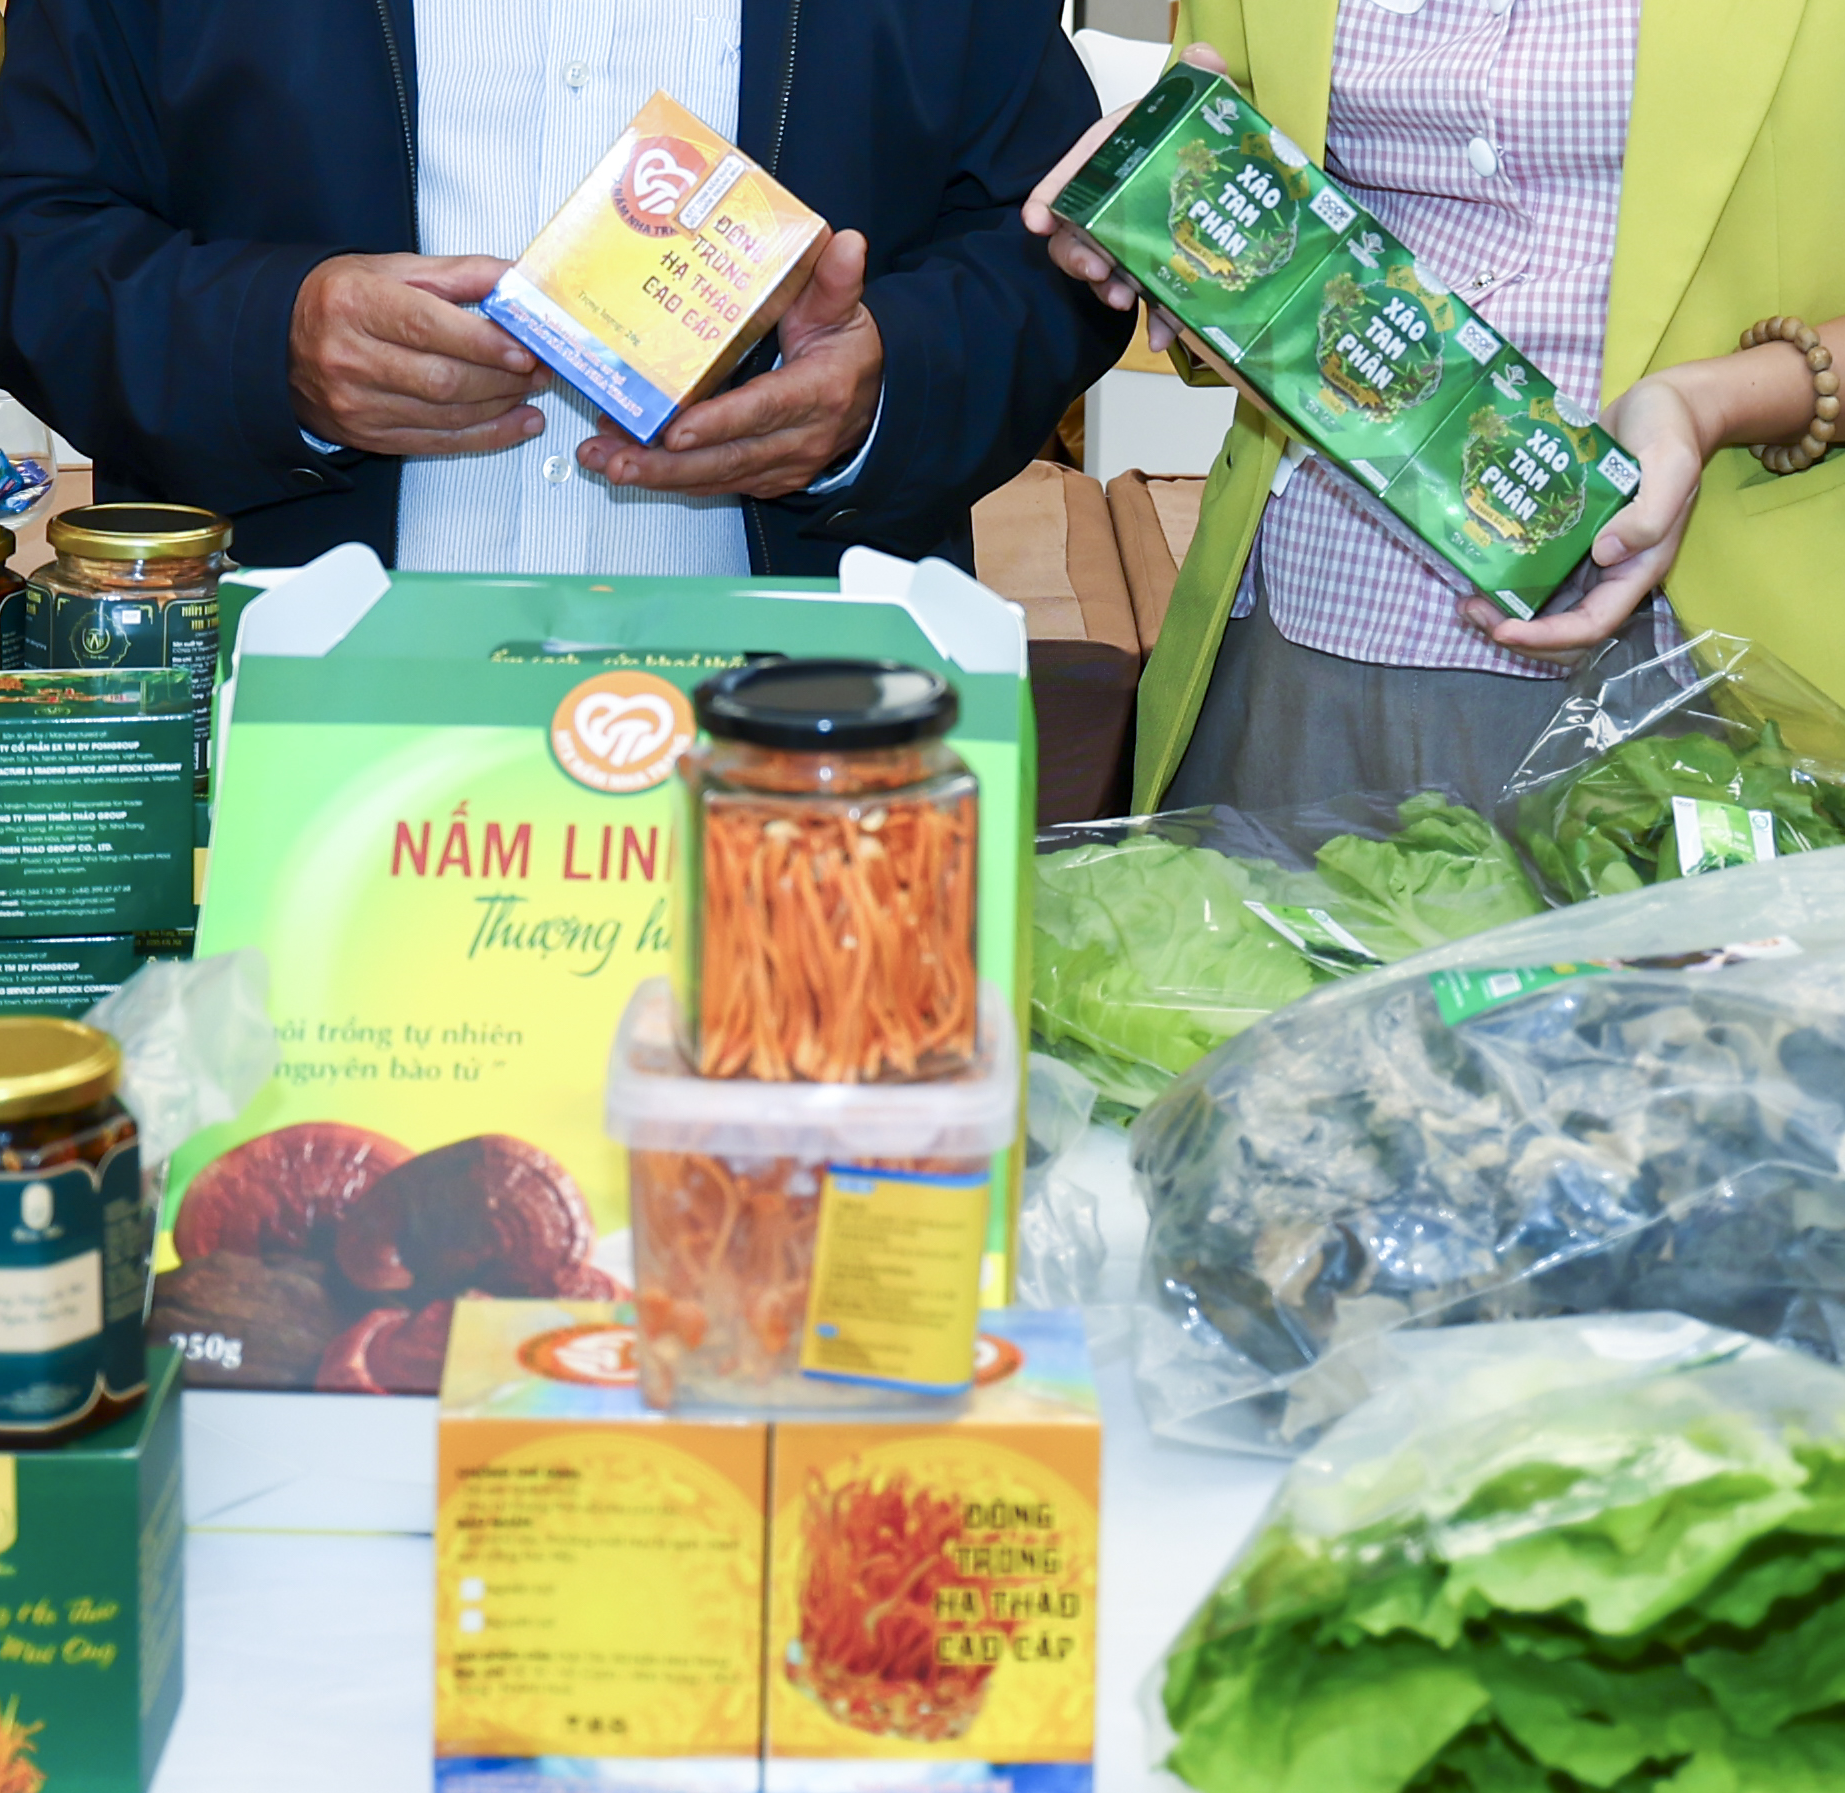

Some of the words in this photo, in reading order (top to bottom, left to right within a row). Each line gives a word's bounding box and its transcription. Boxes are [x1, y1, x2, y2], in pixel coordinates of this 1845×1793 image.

[1217, 181, 1261, 228] TAM
[1236, 164, 1282, 209] XÁO
[1321, 194, 1350, 220] OCOP
[627, 213, 652, 235] NHA
[713, 215, 768, 264] ĐÔNG
[1187, 199, 1248, 258] PHÂN
[691, 235, 751, 291] TRÙNG
[642, 276, 683, 313] CAO
[681, 308, 722, 342] CẤP
[660, 250, 690, 282] HẠ
[690, 273, 742, 324] THẢO
[1365, 315, 1408, 361] TAM
[1382, 296, 1427, 342] XÁO
[1467, 325, 1494, 350] OCOP
[1336, 333, 1395, 390] PHÂN
[1509, 447, 1551, 492] TAM
[1526, 428, 1570, 472] XÁO
[1608, 456, 1636, 482] OCOP
[1480, 465, 1538, 521] PHÂN
[0, 743, 10, 753] TY
[12, 814, 23, 822] TY
[97, 811, 127, 820] GROUP
[47, 844, 76, 854] GROUP
[390, 800, 532, 880] NẤM
[468, 892, 623, 978] Thượng
[442, 1022, 523, 1046] nhiên
[273, 1057, 379, 1085] nguyên
